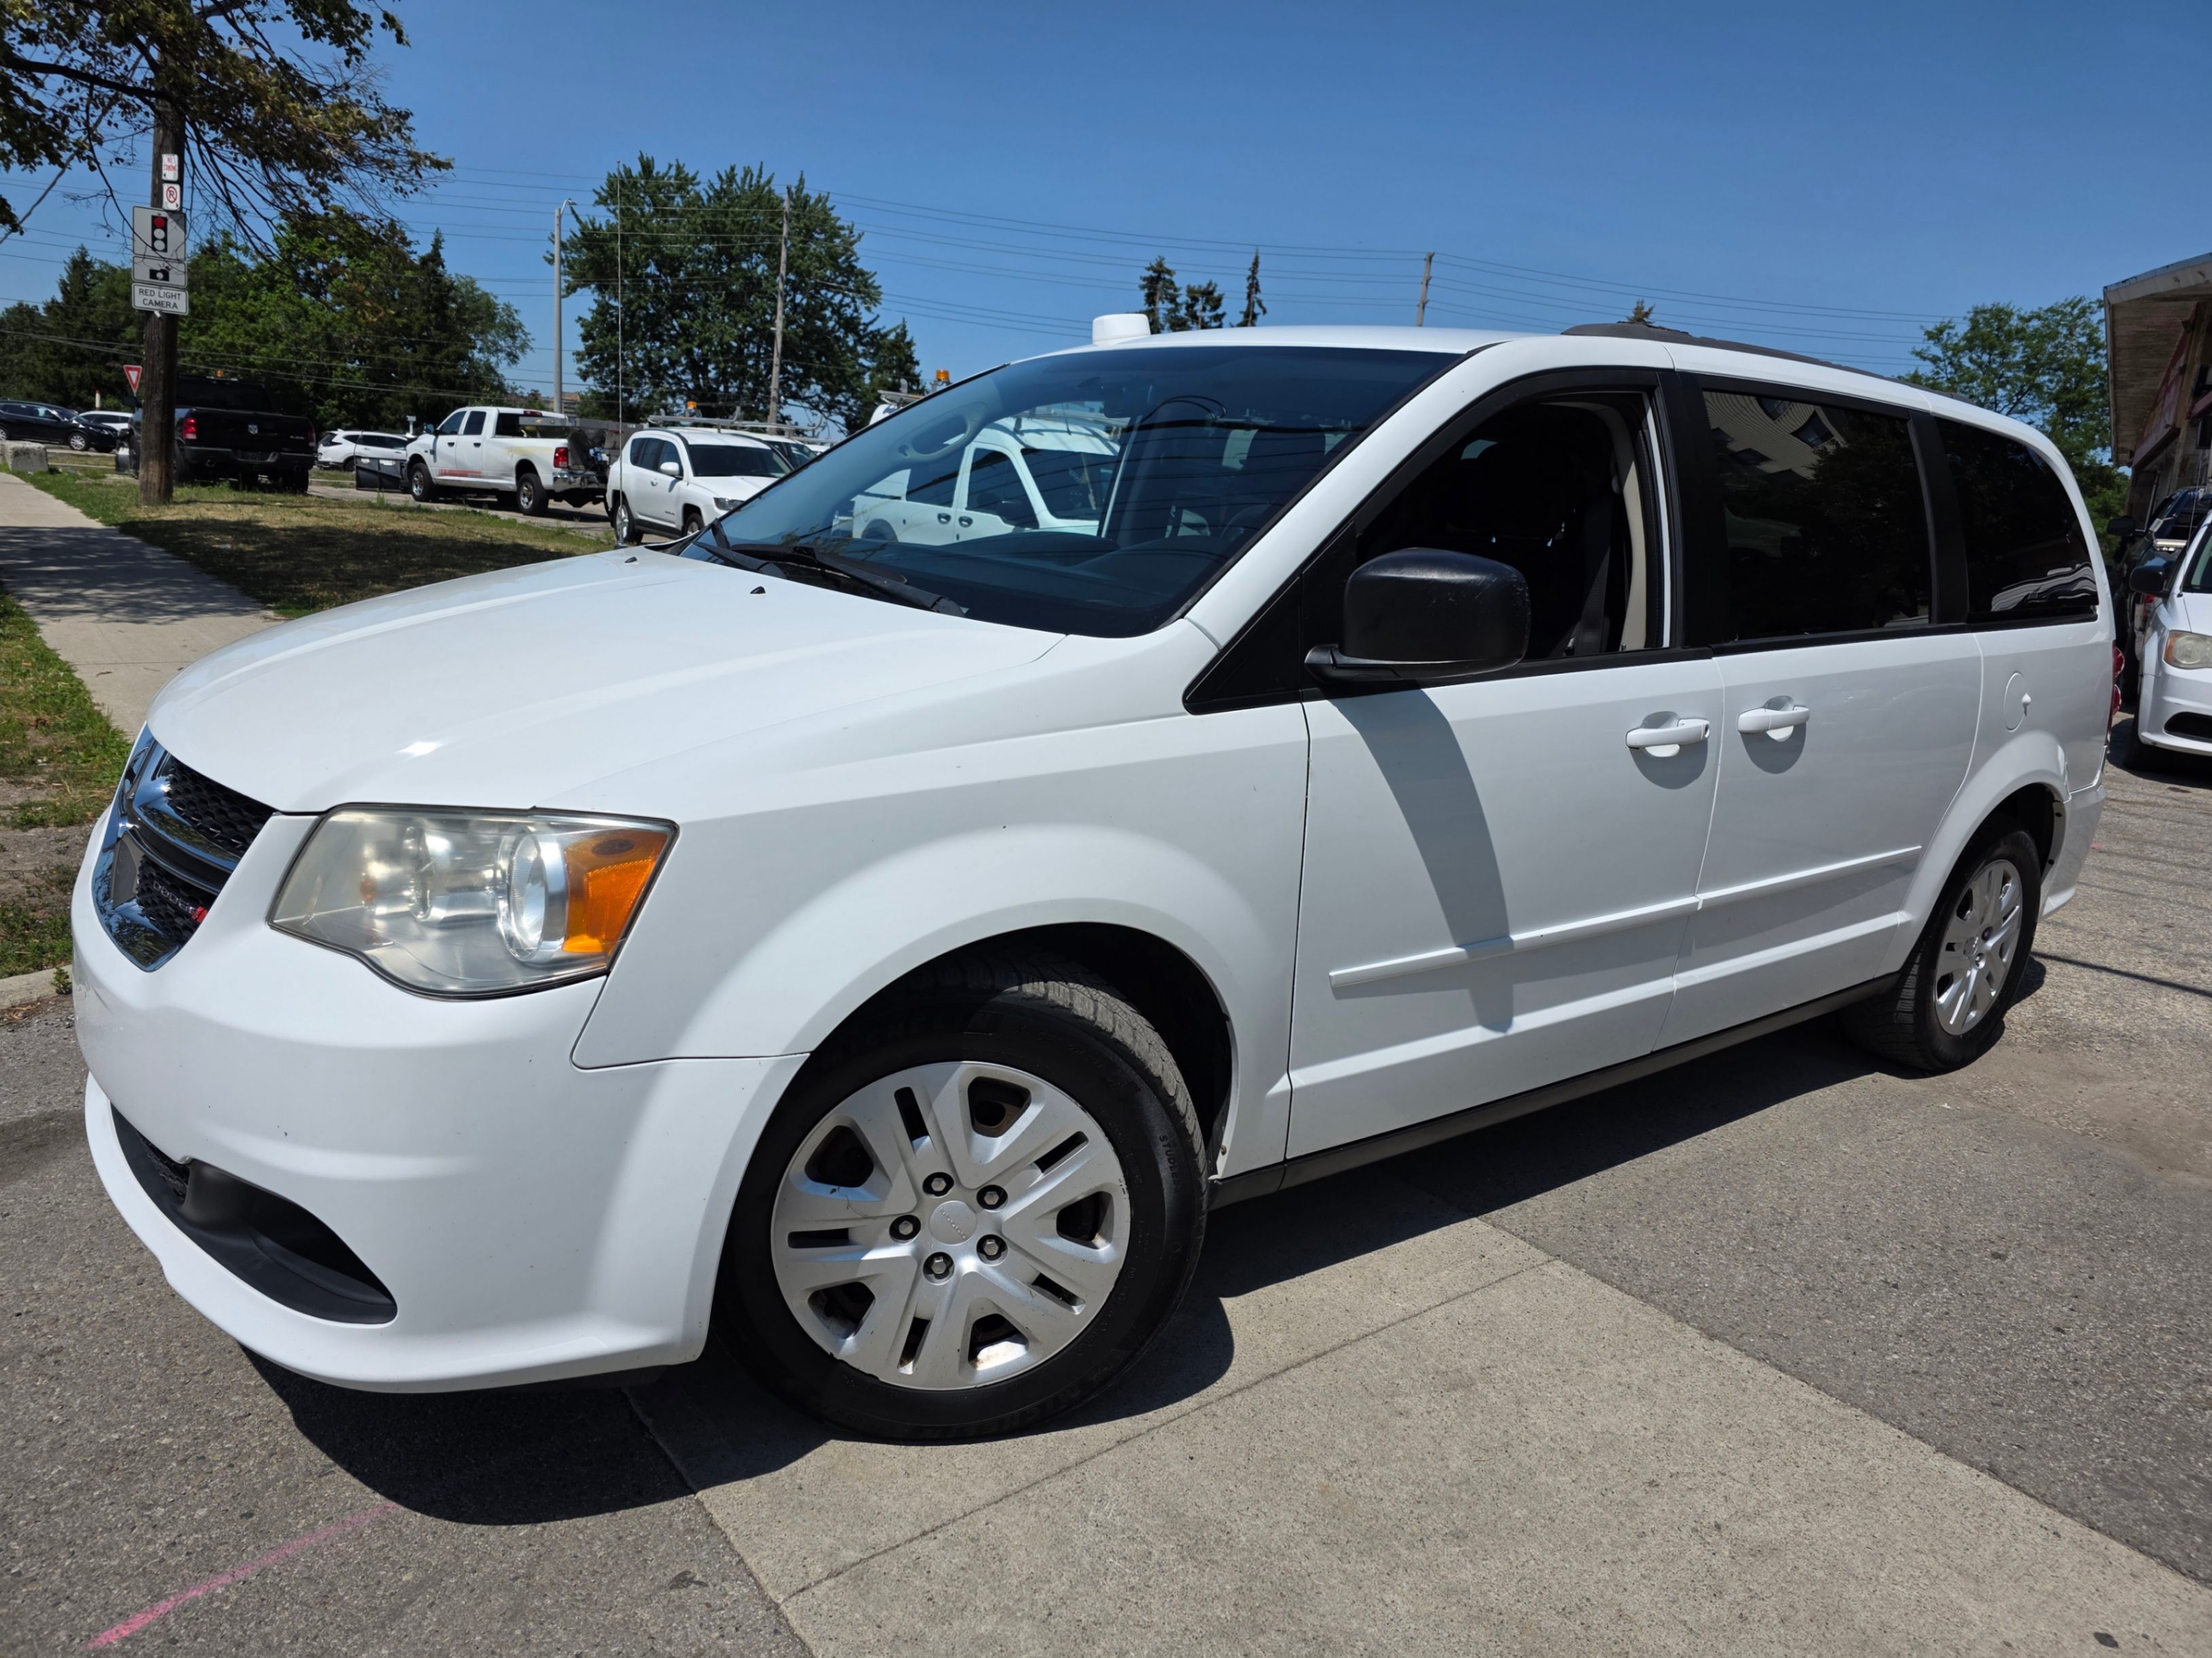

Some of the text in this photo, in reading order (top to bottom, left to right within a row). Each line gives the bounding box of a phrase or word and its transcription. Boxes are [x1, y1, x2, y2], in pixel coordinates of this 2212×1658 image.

[139, 288, 181, 300] RED LIGHT
[143, 298, 179, 310] CAMERA
